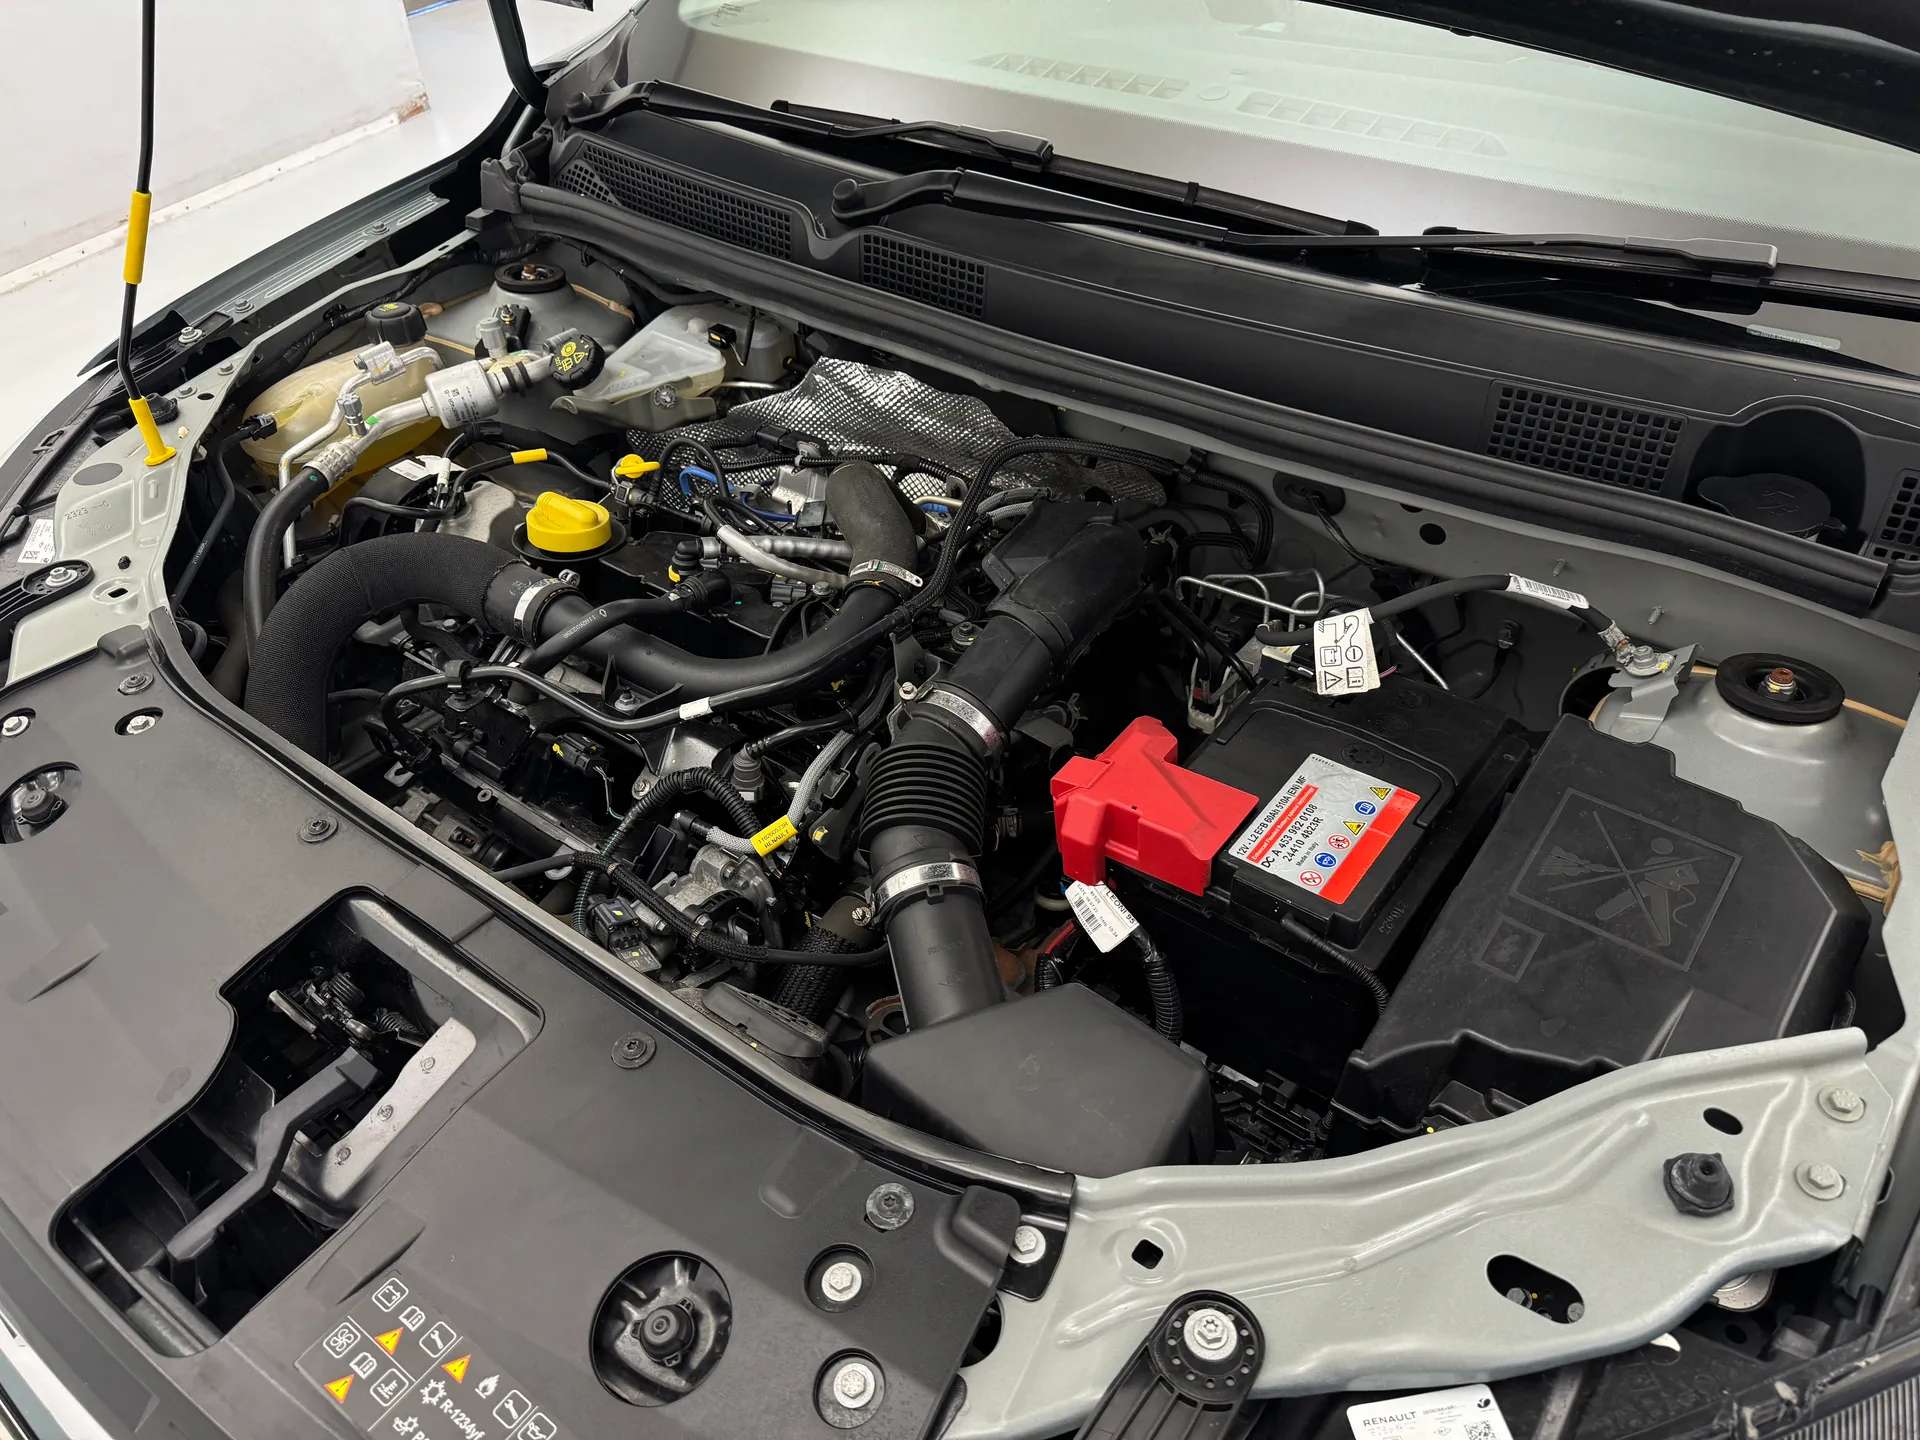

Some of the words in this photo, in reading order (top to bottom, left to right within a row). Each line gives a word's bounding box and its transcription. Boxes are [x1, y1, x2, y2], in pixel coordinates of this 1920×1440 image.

[1237, 844, 1249, 856] 12V
[1248, 833, 1259, 843] L2
[1254, 822, 1269, 835] EFB
[1264, 808, 1279, 823] 60Ah
[1275, 795, 1290, 810] 510A
[1287, 783, 1302, 797] (EN)
[1297, 775, 1306, 786] MF
[1261, 856, 1275, 868] DC
[1272, 849, 1282, 857] A
[1279, 834, 1293, 849] 453
[1299, 804, 1318, 821] 0108
[1282, 839, 1305, 862] 24410
[1301, 817, 1323, 839] 4823R
[1105, 890, 1128, 915] LEONI
[440, 1399, 485, 1440] R-1234yf
[1363, 1411, 1417, 1427] RENAULT
